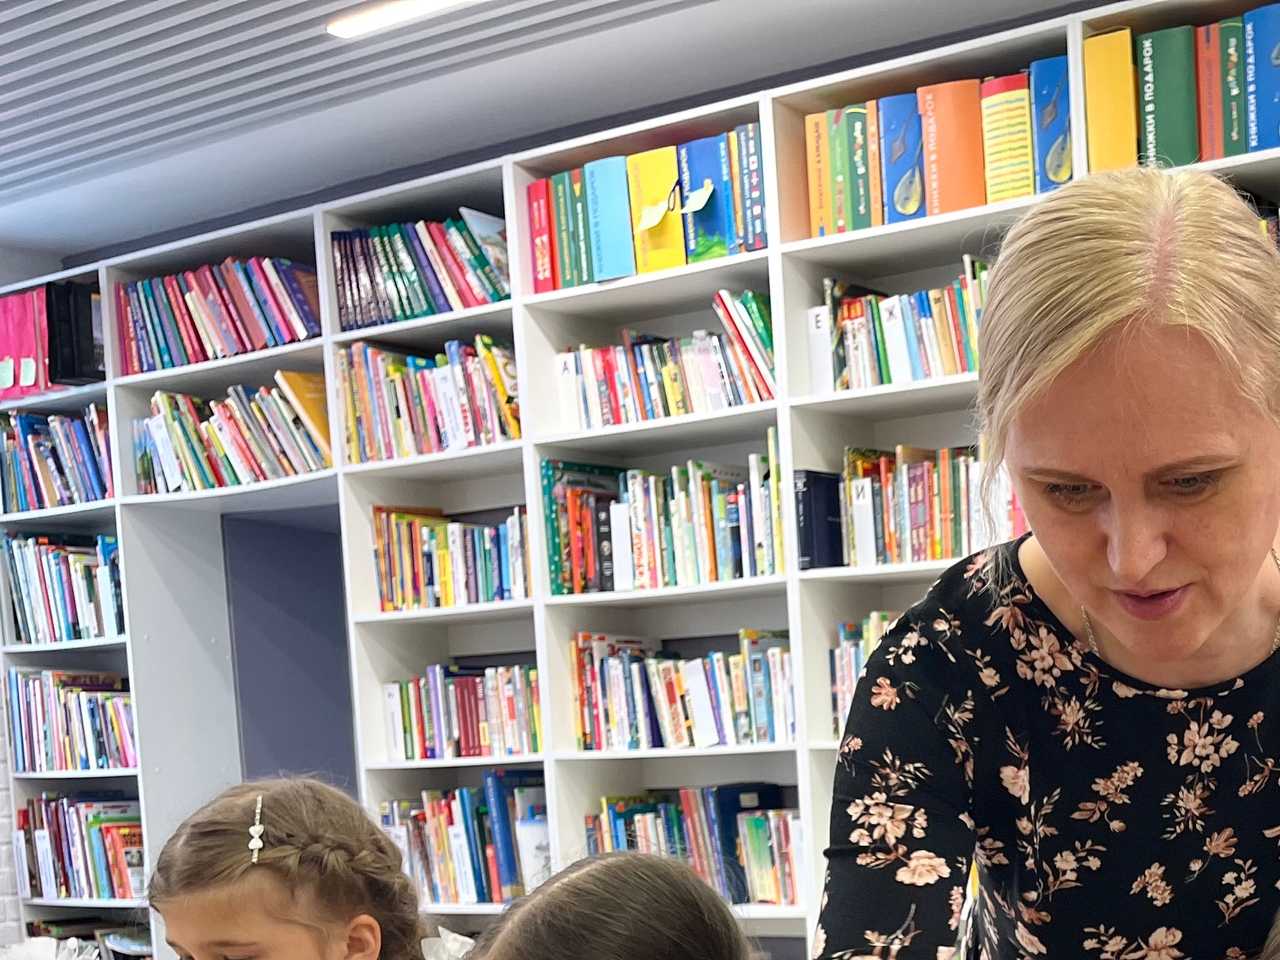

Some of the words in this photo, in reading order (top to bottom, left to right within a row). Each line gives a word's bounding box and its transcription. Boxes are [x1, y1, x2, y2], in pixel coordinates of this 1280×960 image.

[1143, 38, 1155, 101] ПОДАРОК
[1245, 21, 1256, 82] ПОДАРОК
[1247, 94, 1259, 147] КНИЖКИ
